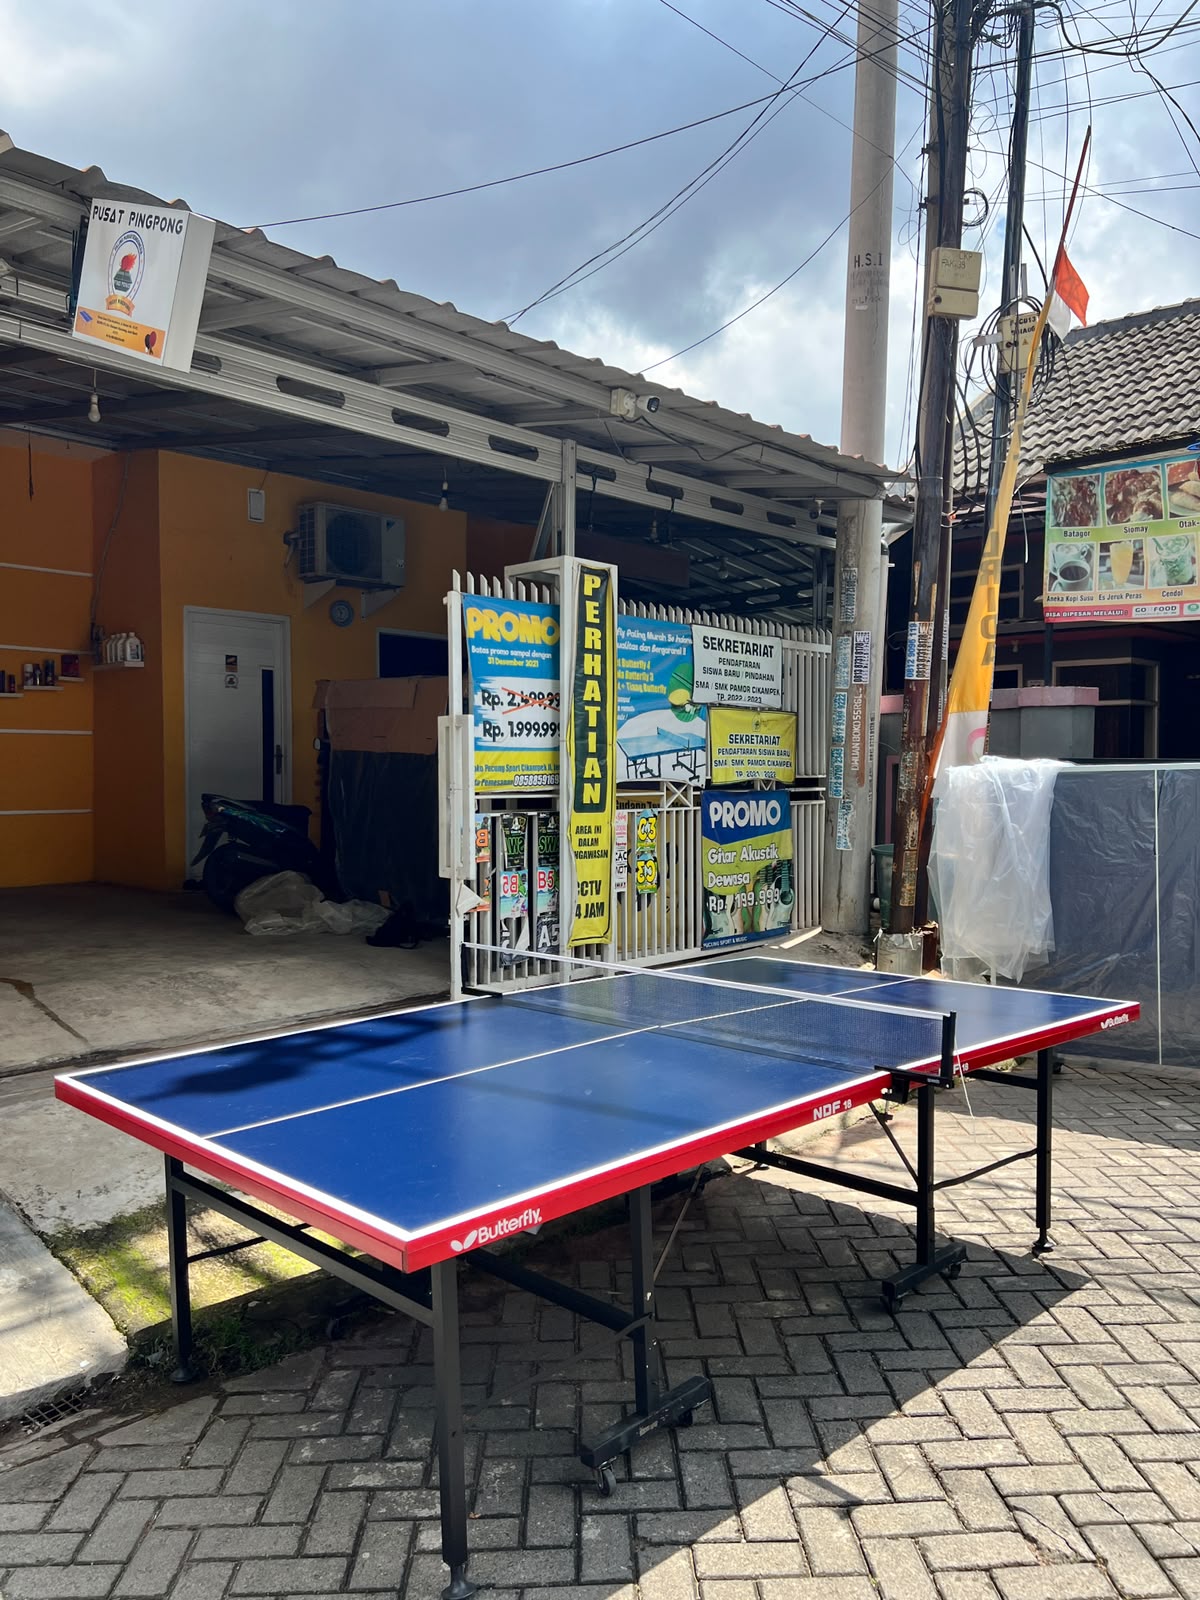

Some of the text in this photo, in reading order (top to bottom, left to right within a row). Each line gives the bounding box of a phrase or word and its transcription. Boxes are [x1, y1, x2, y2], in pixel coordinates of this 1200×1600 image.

[92, 205, 184, 235] PUSAT PINGPONG
[1063, 530, 1091, 538] Batagor
[1123, 526, 1149, 534] Siomay
[1066, 595, 1079, 603] Kopi
[1107, 593, 1124, 601] Jeruk
[1125, 592, 1142, 600] Peras
[1161, 589, 1183, 598] Cendol
[466, 607, 560, 646] PROMO
[490, 647, 509, 657] promo
[702, 635, 774, 658] SEKRETARIAT
[719, 657, 761, 669] PENDAFTARAN
[702, 666, 723, 676] SISWA
[724, 668, 740, 678] BARU
[744, 671, 775, 681] PINDAHAN
[583, 573, 602, 804] PERHATIAN
[695, 680, 710, 689] SMA
[714, 682, 728, 691] SMK
[729, 683, 751, 693] PAMOR
[751, 686, 780, 696] CIKAMPEK
[481, 690, 504, 711] Rp.
[482, 720, 504, 742] Rp.
[729, 733, 780, 746] SEKRETARIAT
[717, 748, 757, 756] PENDAFTARAN
[758, 748, 776, 756] SISWA
[731, 759, 745, 767] SMK
[709, 800, 781, 829] PROMO
[575, 825, 592, 835] AREA
[578, 838, 599, 847] DALAM
[708, 844, 779, 864] Gitar Akustik
[537, 870, 555, 890] B5
[708, 872, 750, 889] Dewasa
[708, 887, 780, 914] Rp. 199.999
[584, 901, 605, 919] JAM
[813, 1099, 852, 1121] NDF 18
[478, 1207, 541, 1244] Butterfly
